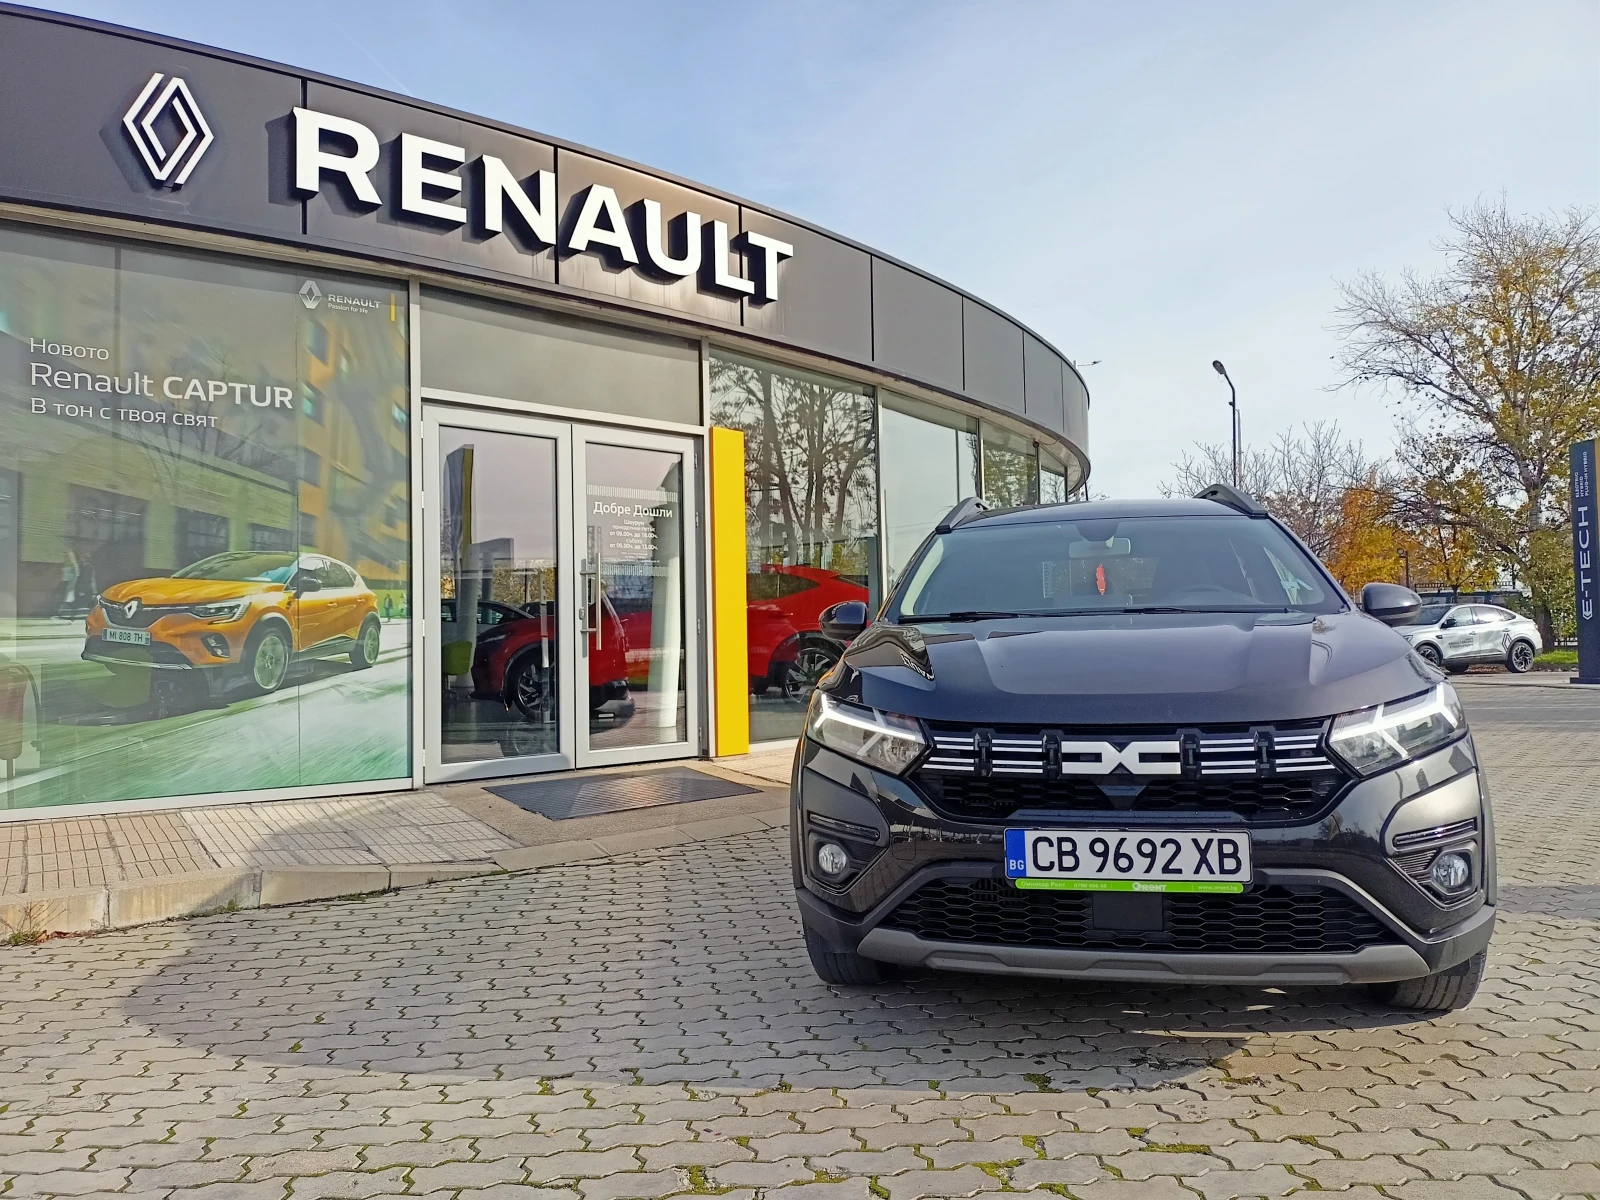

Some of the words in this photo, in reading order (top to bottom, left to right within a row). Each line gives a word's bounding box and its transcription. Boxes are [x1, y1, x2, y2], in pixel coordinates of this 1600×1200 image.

[293, 107, 794, 301] RENAULT
[328, 293, 381, 309] RENAULT
[328, 303, 350, 312] Passion
[350, 305, 359, 313] for
[359, 306, 369, 314] life
[29, 337, 109, 360] Новото
[30, 362, 154, 397] Renault
[162, 376, 293, 409] CAPTUR
[31, 398, 46, 414] В
[53, 403, 93, 418] тон
[100, 407, 111, 420] с
[117, 408, 166, 424] твоя
[172, 413, 218, 428] свят
[593, 501, 631, 517] Добре
[633, 504, 673, 518] Дошли
[1577, 506, 1593, 620] E-TECH
[110, 631, 116, 640] MI
[119, 632, 131, 642] 808
[134, 633, 143, 642] TH
[1009, 859, 1025, 871] BG
[1031, 836, 1080, 872] CB
[1088, 837, 1183, 874] 9692
[1191, 838, 1242, 875] XB
